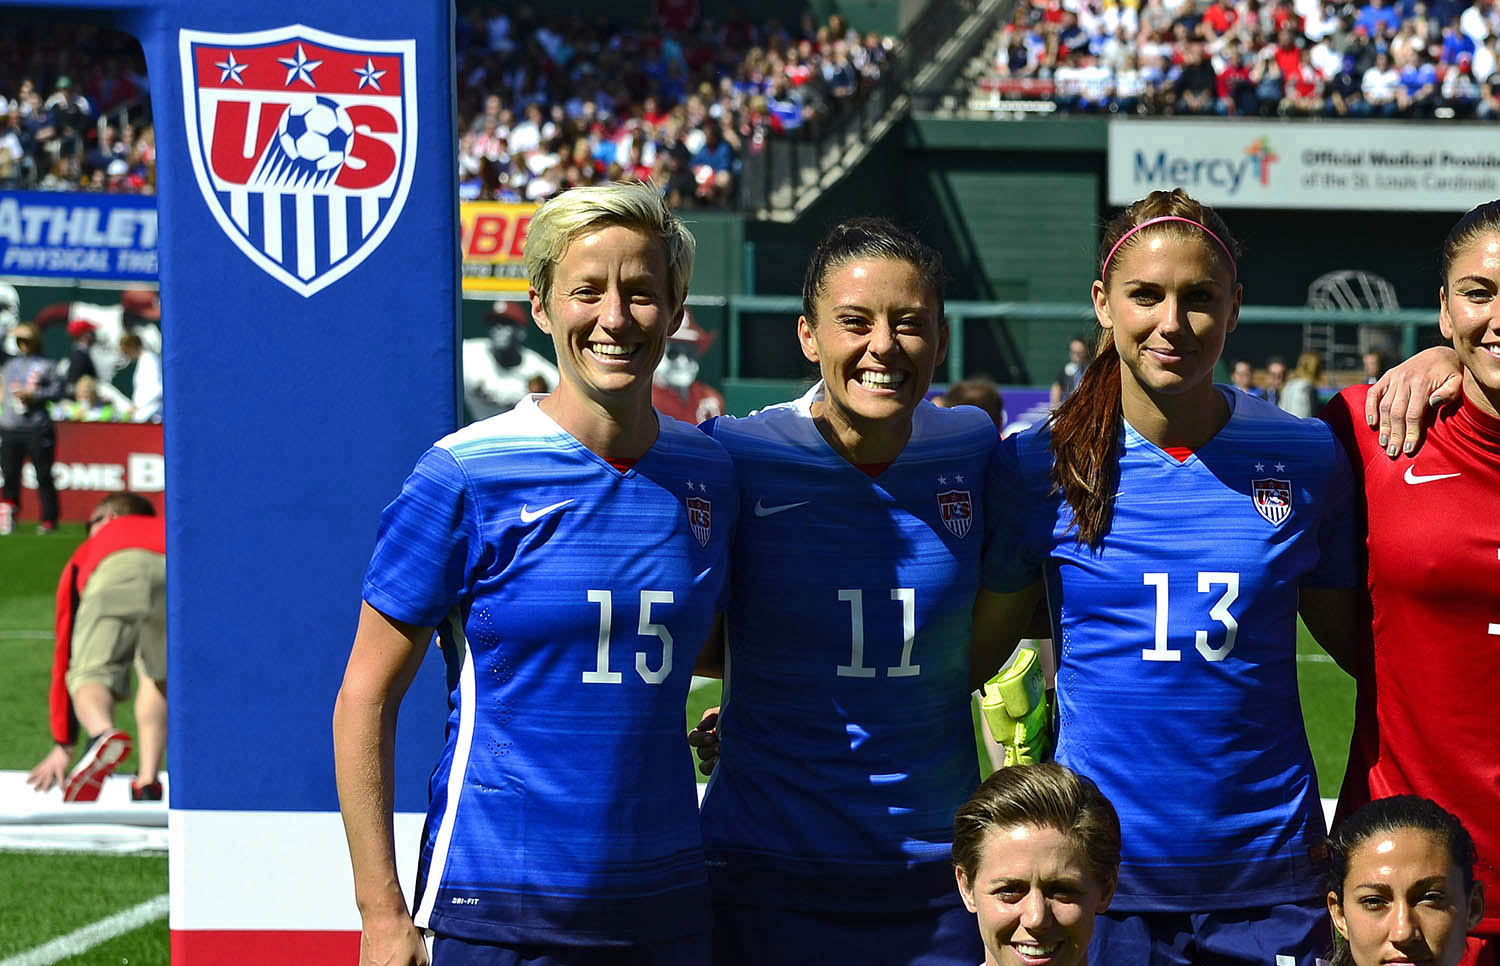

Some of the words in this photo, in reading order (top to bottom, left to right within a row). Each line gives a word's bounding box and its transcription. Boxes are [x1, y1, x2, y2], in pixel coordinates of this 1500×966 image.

[1133, 149, 1248, 196] Mercy
[1302, 149, 1363, 167] Official
[1369, 150, 1434, 168] Medical
[581, 589, 675, 685] 15
[836, 588, 921, 678] 11
[1141, 572, 1240, 662] 13
